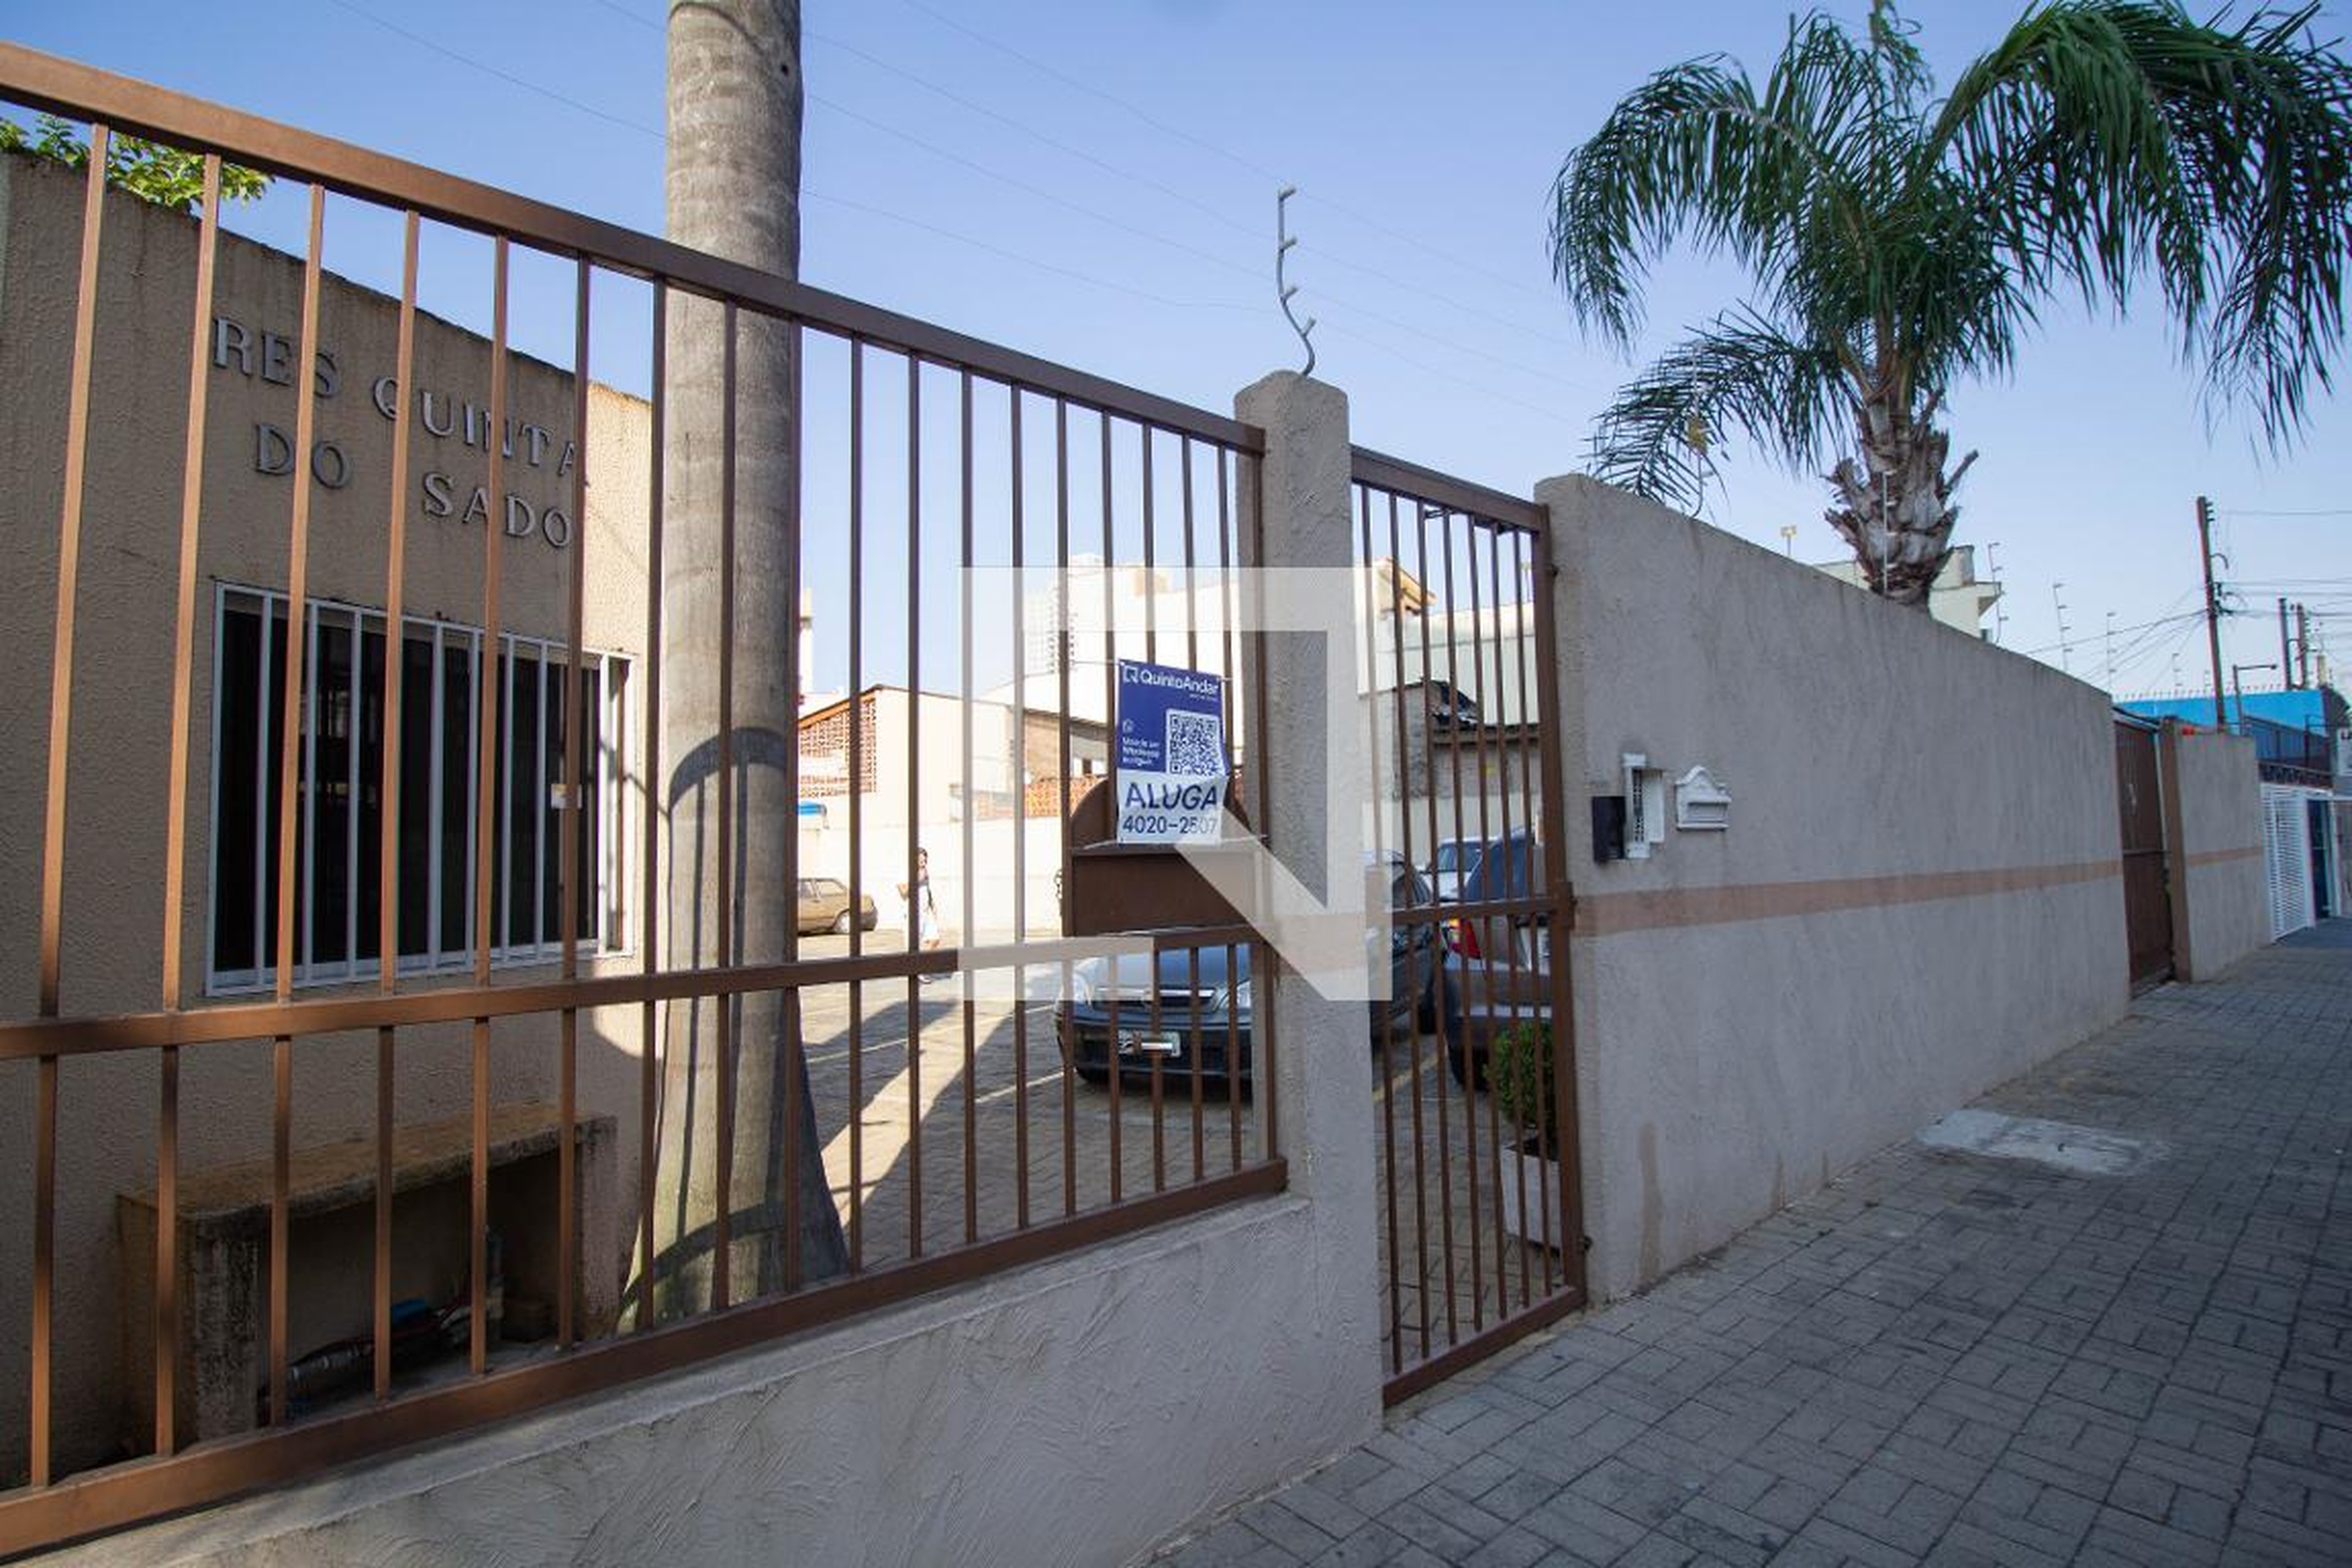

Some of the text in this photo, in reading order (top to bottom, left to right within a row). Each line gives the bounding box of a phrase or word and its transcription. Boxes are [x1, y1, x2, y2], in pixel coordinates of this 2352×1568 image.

[214, 316, 340, 398] RES
[255, 424, 572, 548] DO SADO
[1140, 669, 1218, 695] QuintoAndar
[1125, 782, 1218, 810] ALUGA
[1122, 815, 1218, 834] 4020-2507
